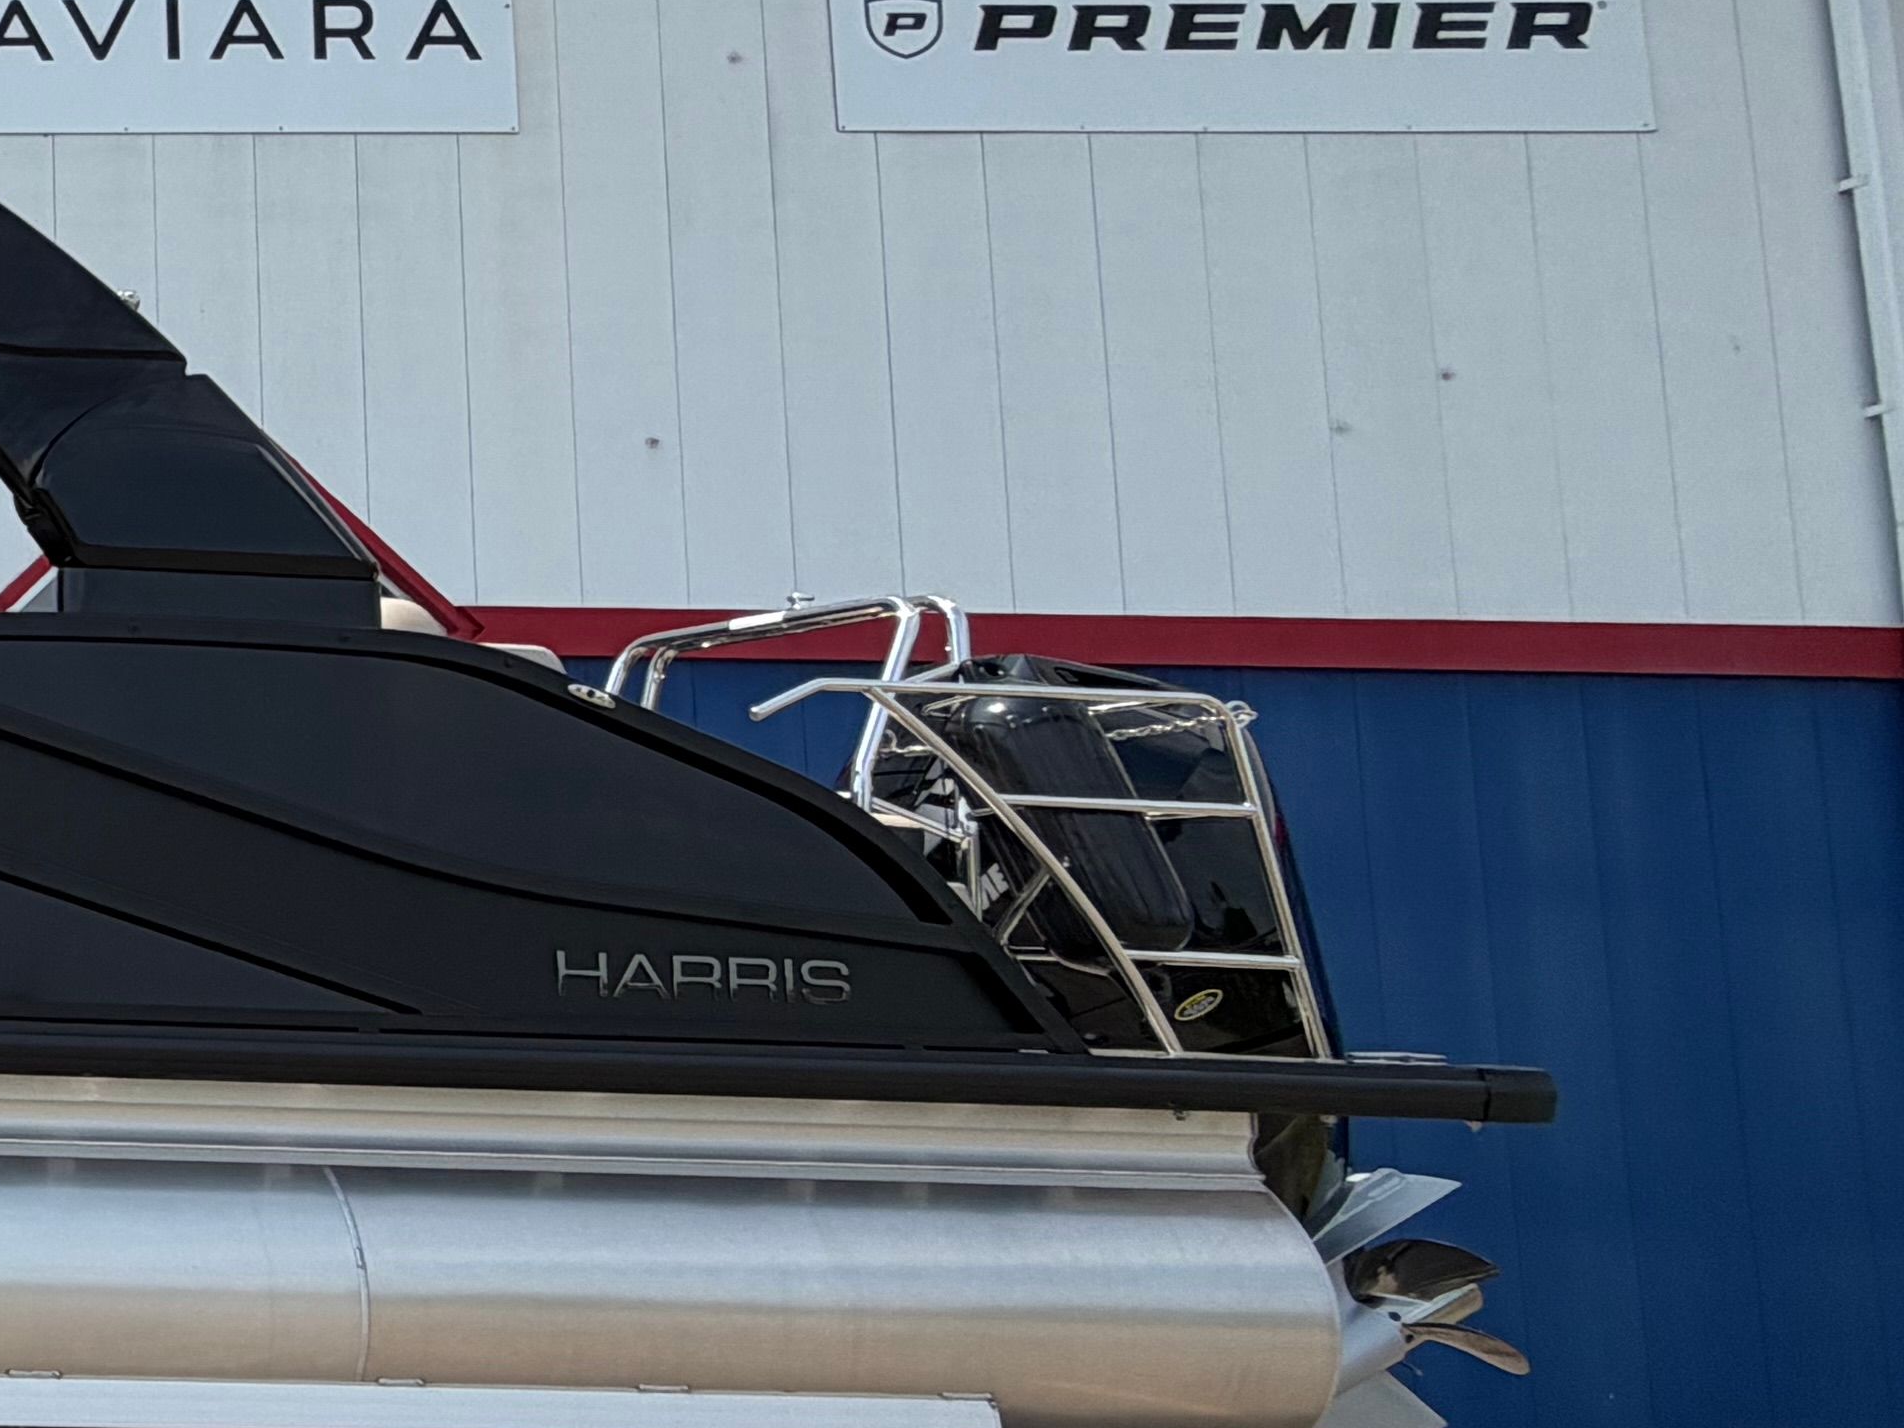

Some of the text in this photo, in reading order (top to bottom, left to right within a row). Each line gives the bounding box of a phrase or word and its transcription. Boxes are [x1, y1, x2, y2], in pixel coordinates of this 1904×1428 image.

[883, 12, 927, 37] P
[974, 1, 1593, 51] PREMIER
[556, 949, 852, 1004] HARRIS
